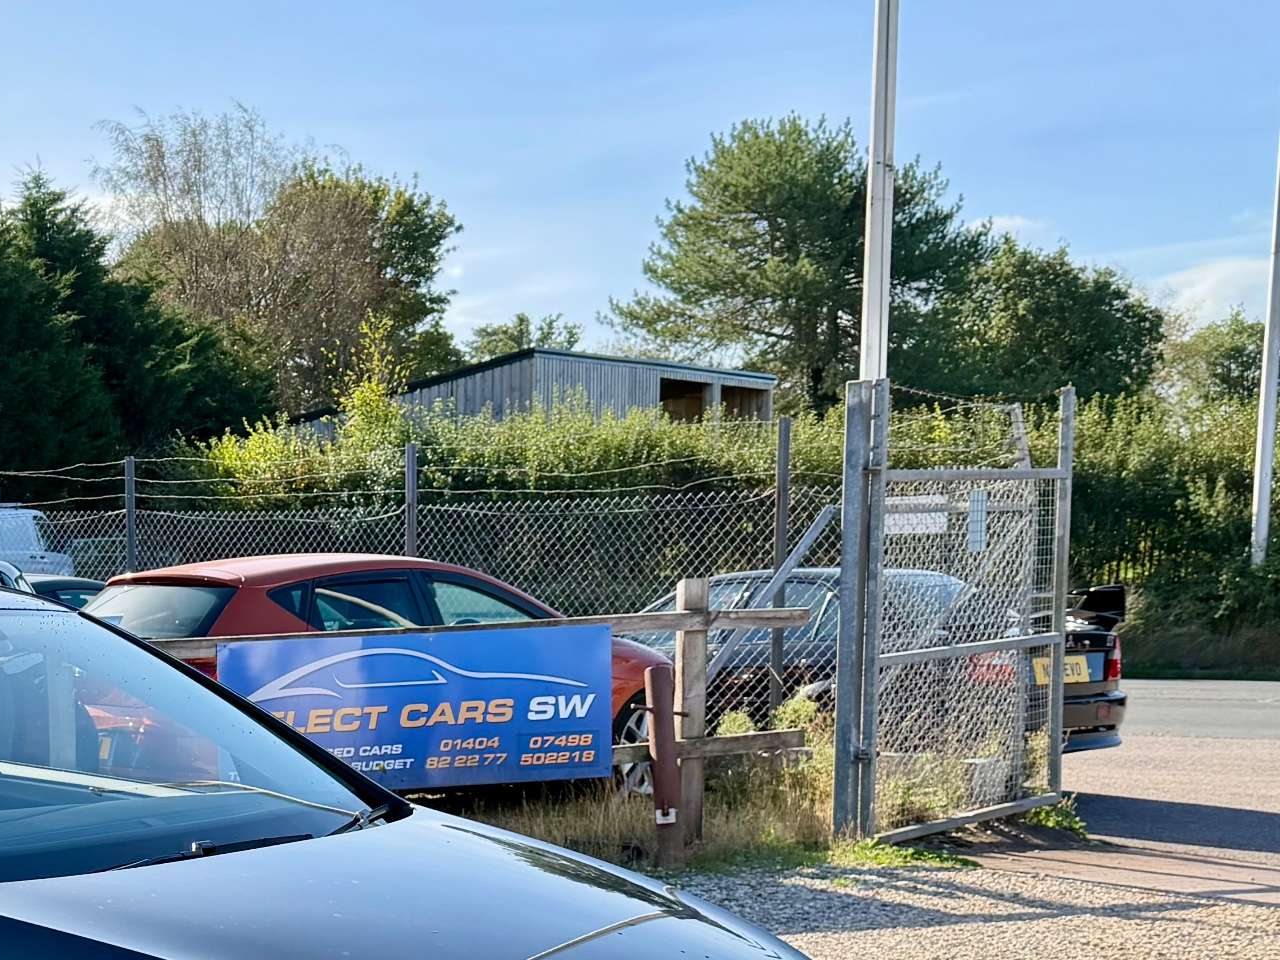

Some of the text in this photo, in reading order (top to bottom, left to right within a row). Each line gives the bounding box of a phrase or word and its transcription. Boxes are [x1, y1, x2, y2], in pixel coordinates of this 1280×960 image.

[399, 698, 514, 728] CARS
[527, 693, 596, 721] SW
[439, 736, 500, 752] 01404
[529, 733, 593, 749] 07498
[359, 744, 403, 756] CARS
[519, 750, 595, 766] 502218
[350, 758, 415, 771] BUDGET
